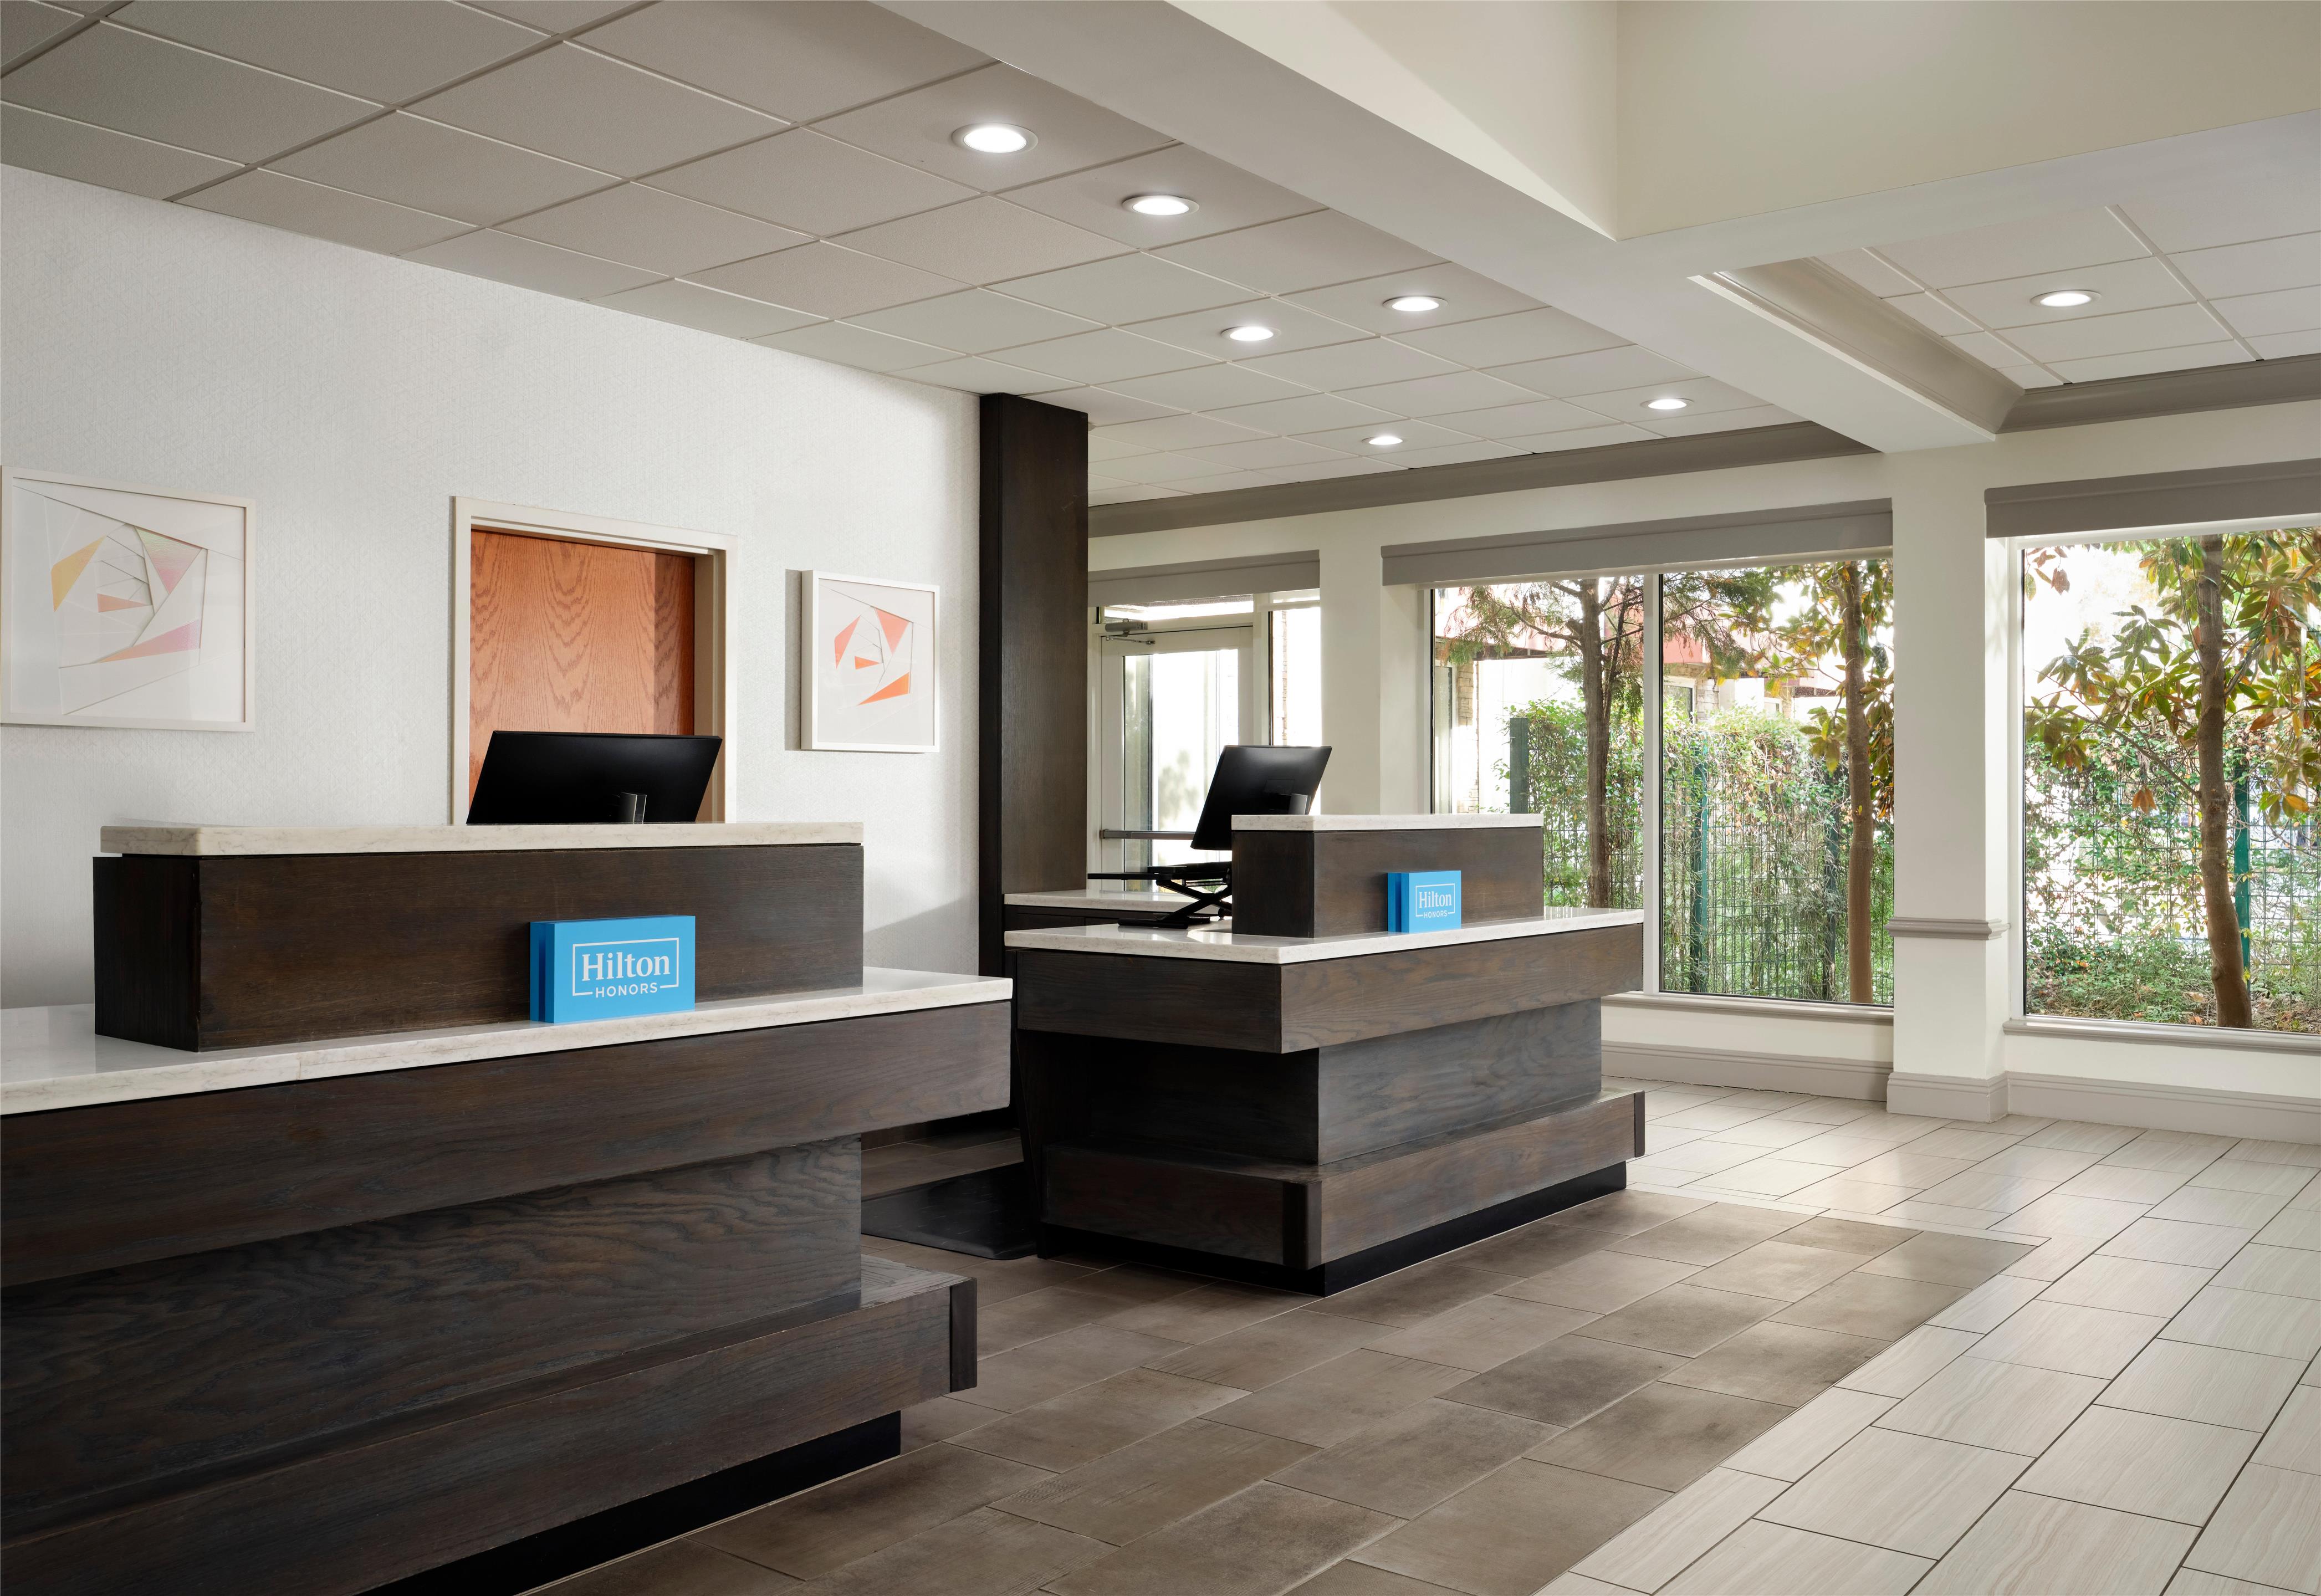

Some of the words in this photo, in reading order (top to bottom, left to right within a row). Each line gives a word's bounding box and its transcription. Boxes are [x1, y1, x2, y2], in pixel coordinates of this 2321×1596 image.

[1419, 891, 1452, 908] Hilton
[1424, 910, 1448, 918] HONORS
[582, 952, 670, 981] Hilton
[596, 982, 658, 998] HONORS
